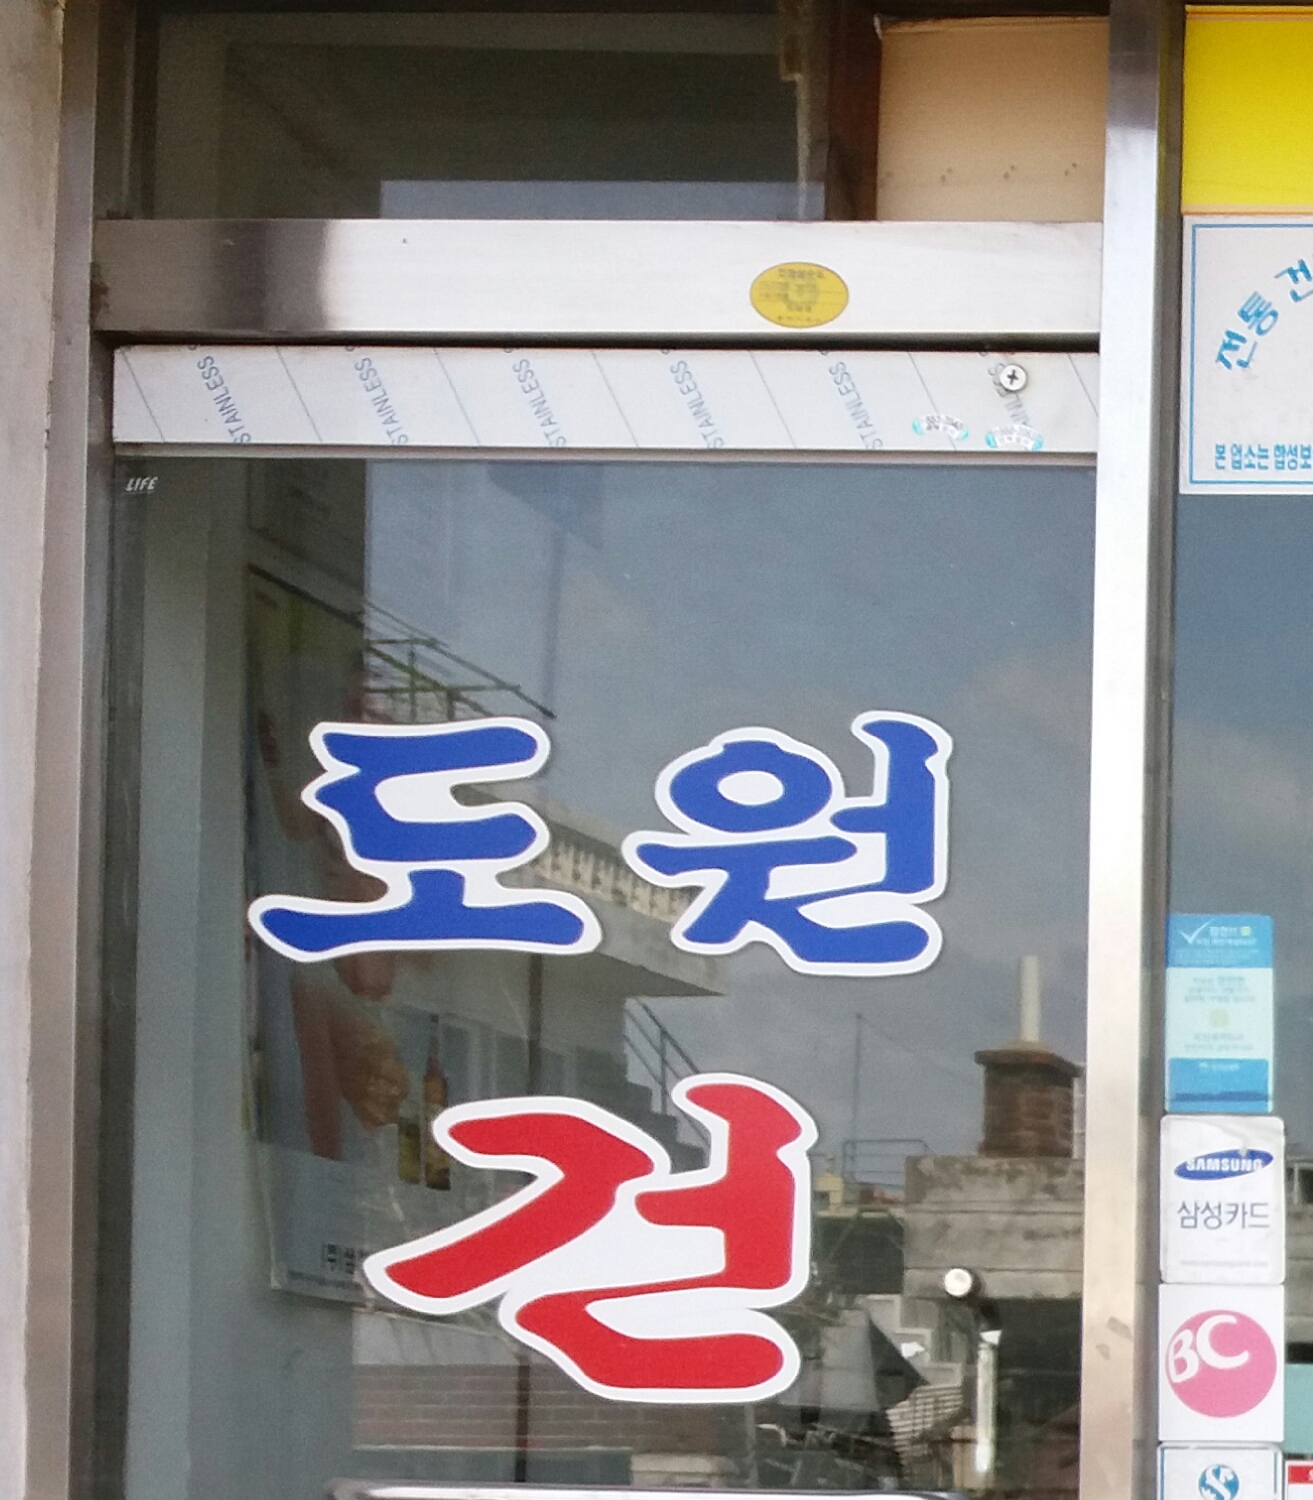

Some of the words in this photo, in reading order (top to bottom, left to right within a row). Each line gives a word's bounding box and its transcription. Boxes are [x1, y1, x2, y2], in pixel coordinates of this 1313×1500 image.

[1215, 290, 1280, 370] 전통
[1214, 442, 1227, 470] 본
[1230, 442, 1270, 471] 업소는
[125, 476, 159, 492] LIFE
[247, 709, 954, 977] 도원
[1186, 1157, 1263, 1172] SAMSUNG
[1177, 1201, 1271, 1230] 삼성카드
[1168, 1314, 1250, 1384] BC
